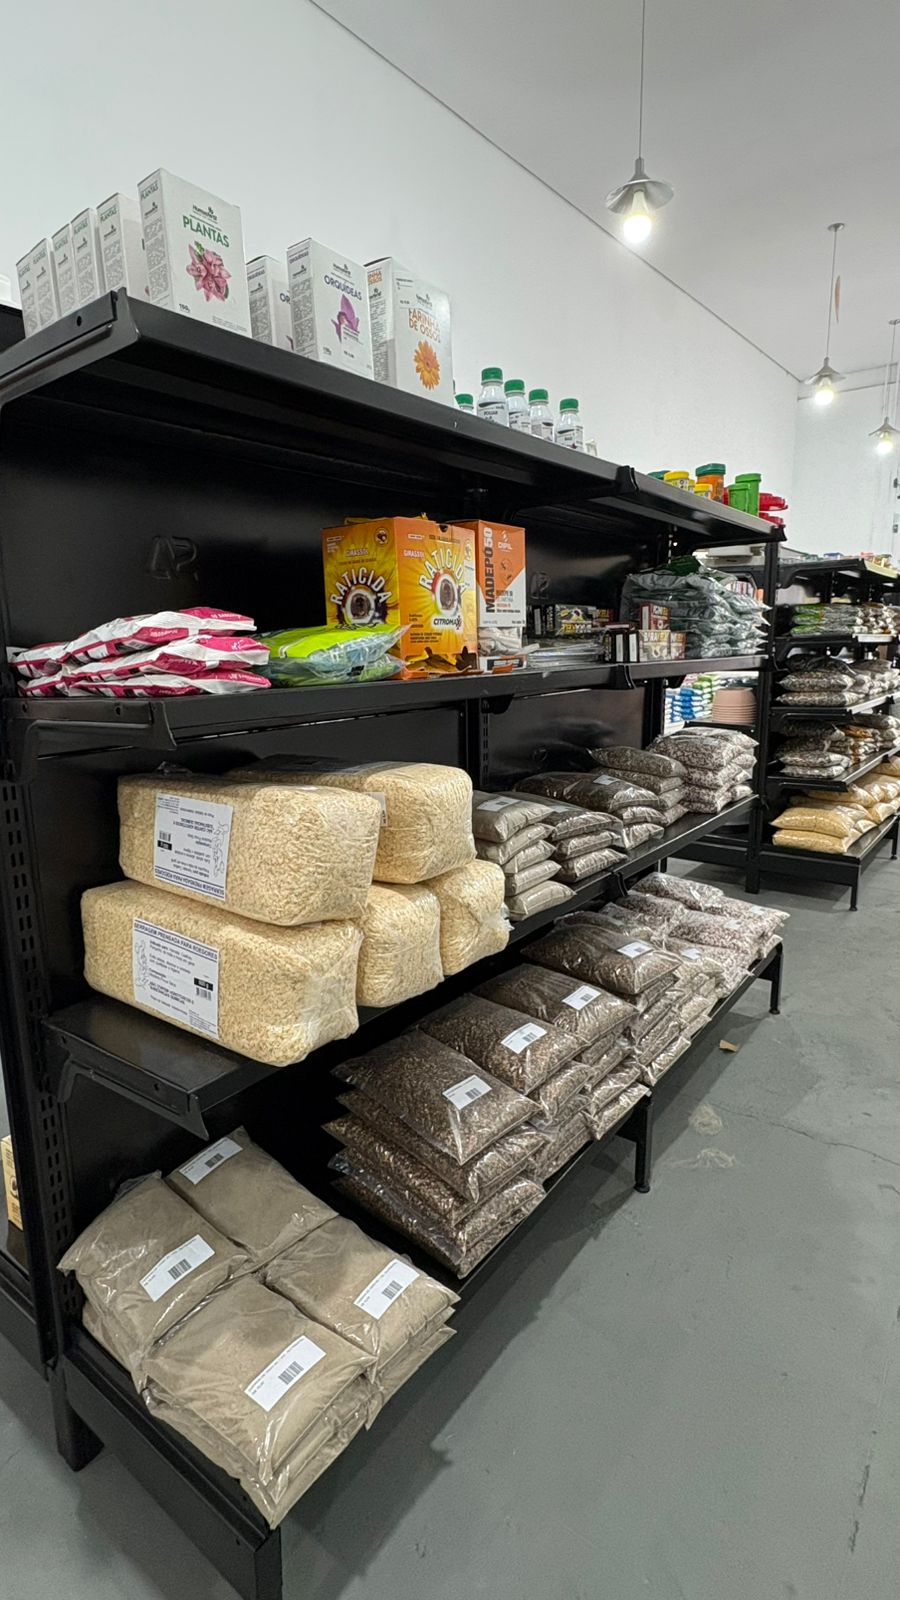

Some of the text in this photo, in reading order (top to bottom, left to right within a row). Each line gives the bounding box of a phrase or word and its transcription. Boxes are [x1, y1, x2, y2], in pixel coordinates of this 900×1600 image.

[183, 215, 230, 248] PLANTAS
[323, 274, 362, 301] ORQUÍDEAS
[330, 566, 392, 605] RATICIDA
[419, 548, 468, 593] RATICIDA
